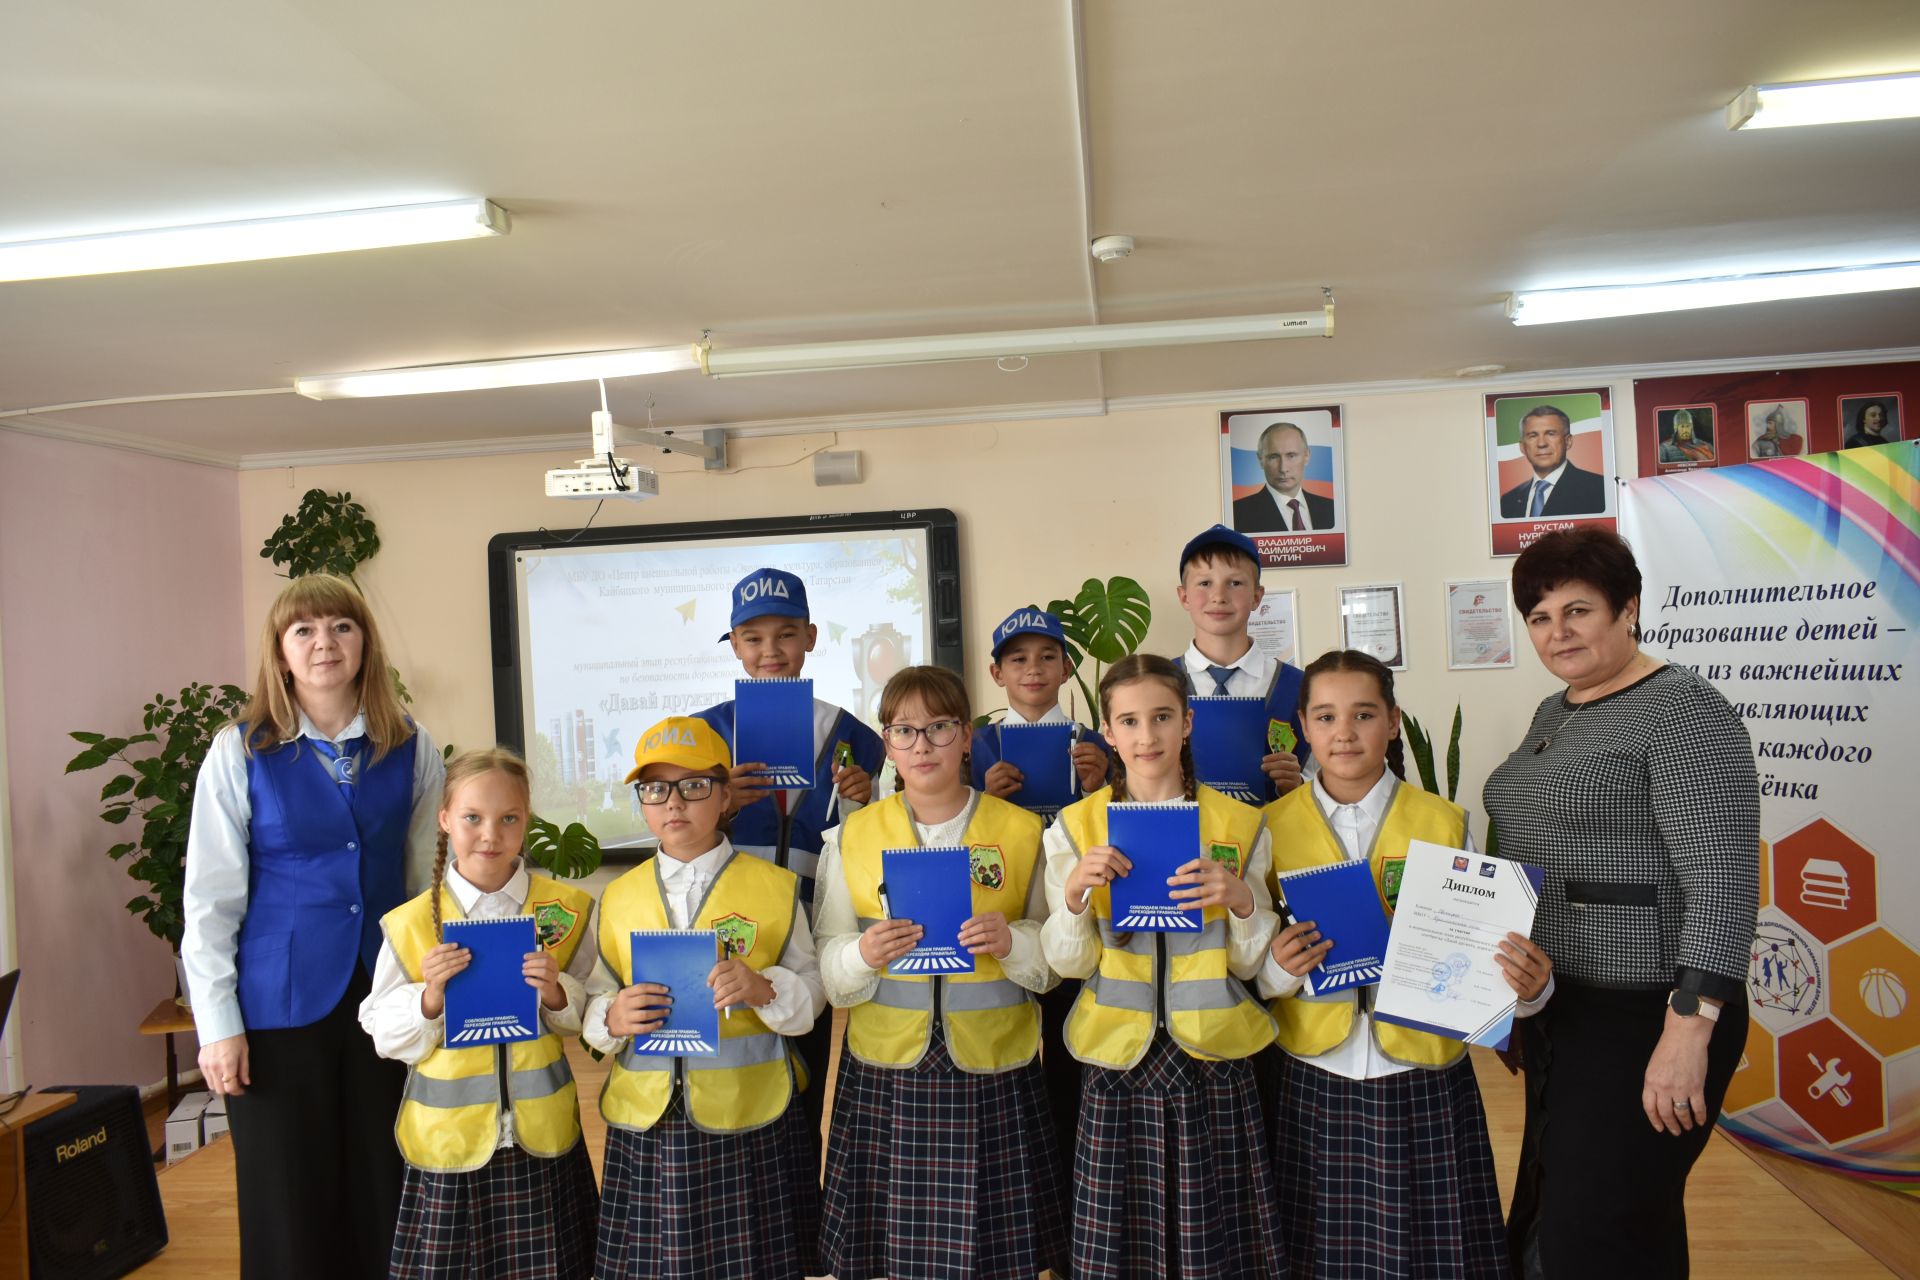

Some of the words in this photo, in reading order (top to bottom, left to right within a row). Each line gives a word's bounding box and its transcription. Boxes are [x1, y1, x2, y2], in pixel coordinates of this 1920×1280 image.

[1533, 522, 1574, 531] РУСТАМ
[1257, 537, 1312, 547] ВЛАДИМИР
[1257, 545, 1326, 554] АДИМИРОВИЧ
[1269, 554, 1302, 562] ПУТИН
[740, 577, 790, 606] ЮИД
[1661, 580, 1877, 612] Дополнительное
[1001, 612, 1048, 638] ЮИД
[1643, 623, 1788, 649] образование
[1795, 615, 1878, 641] детей
[1707, 663, 1731, 681] из
[1740, 657, 1903, 682] важнейших
[1735, 701, 1869, 727] авляющих
[643, 726, 697, 753] ЮИД
[1758, 737, 1873, 764] каждого
[1761, 773, 1819, 800] ёнка
[1442, 877, 1496, 900] Диплом
[56, 1126, 108, 1163] Roland
